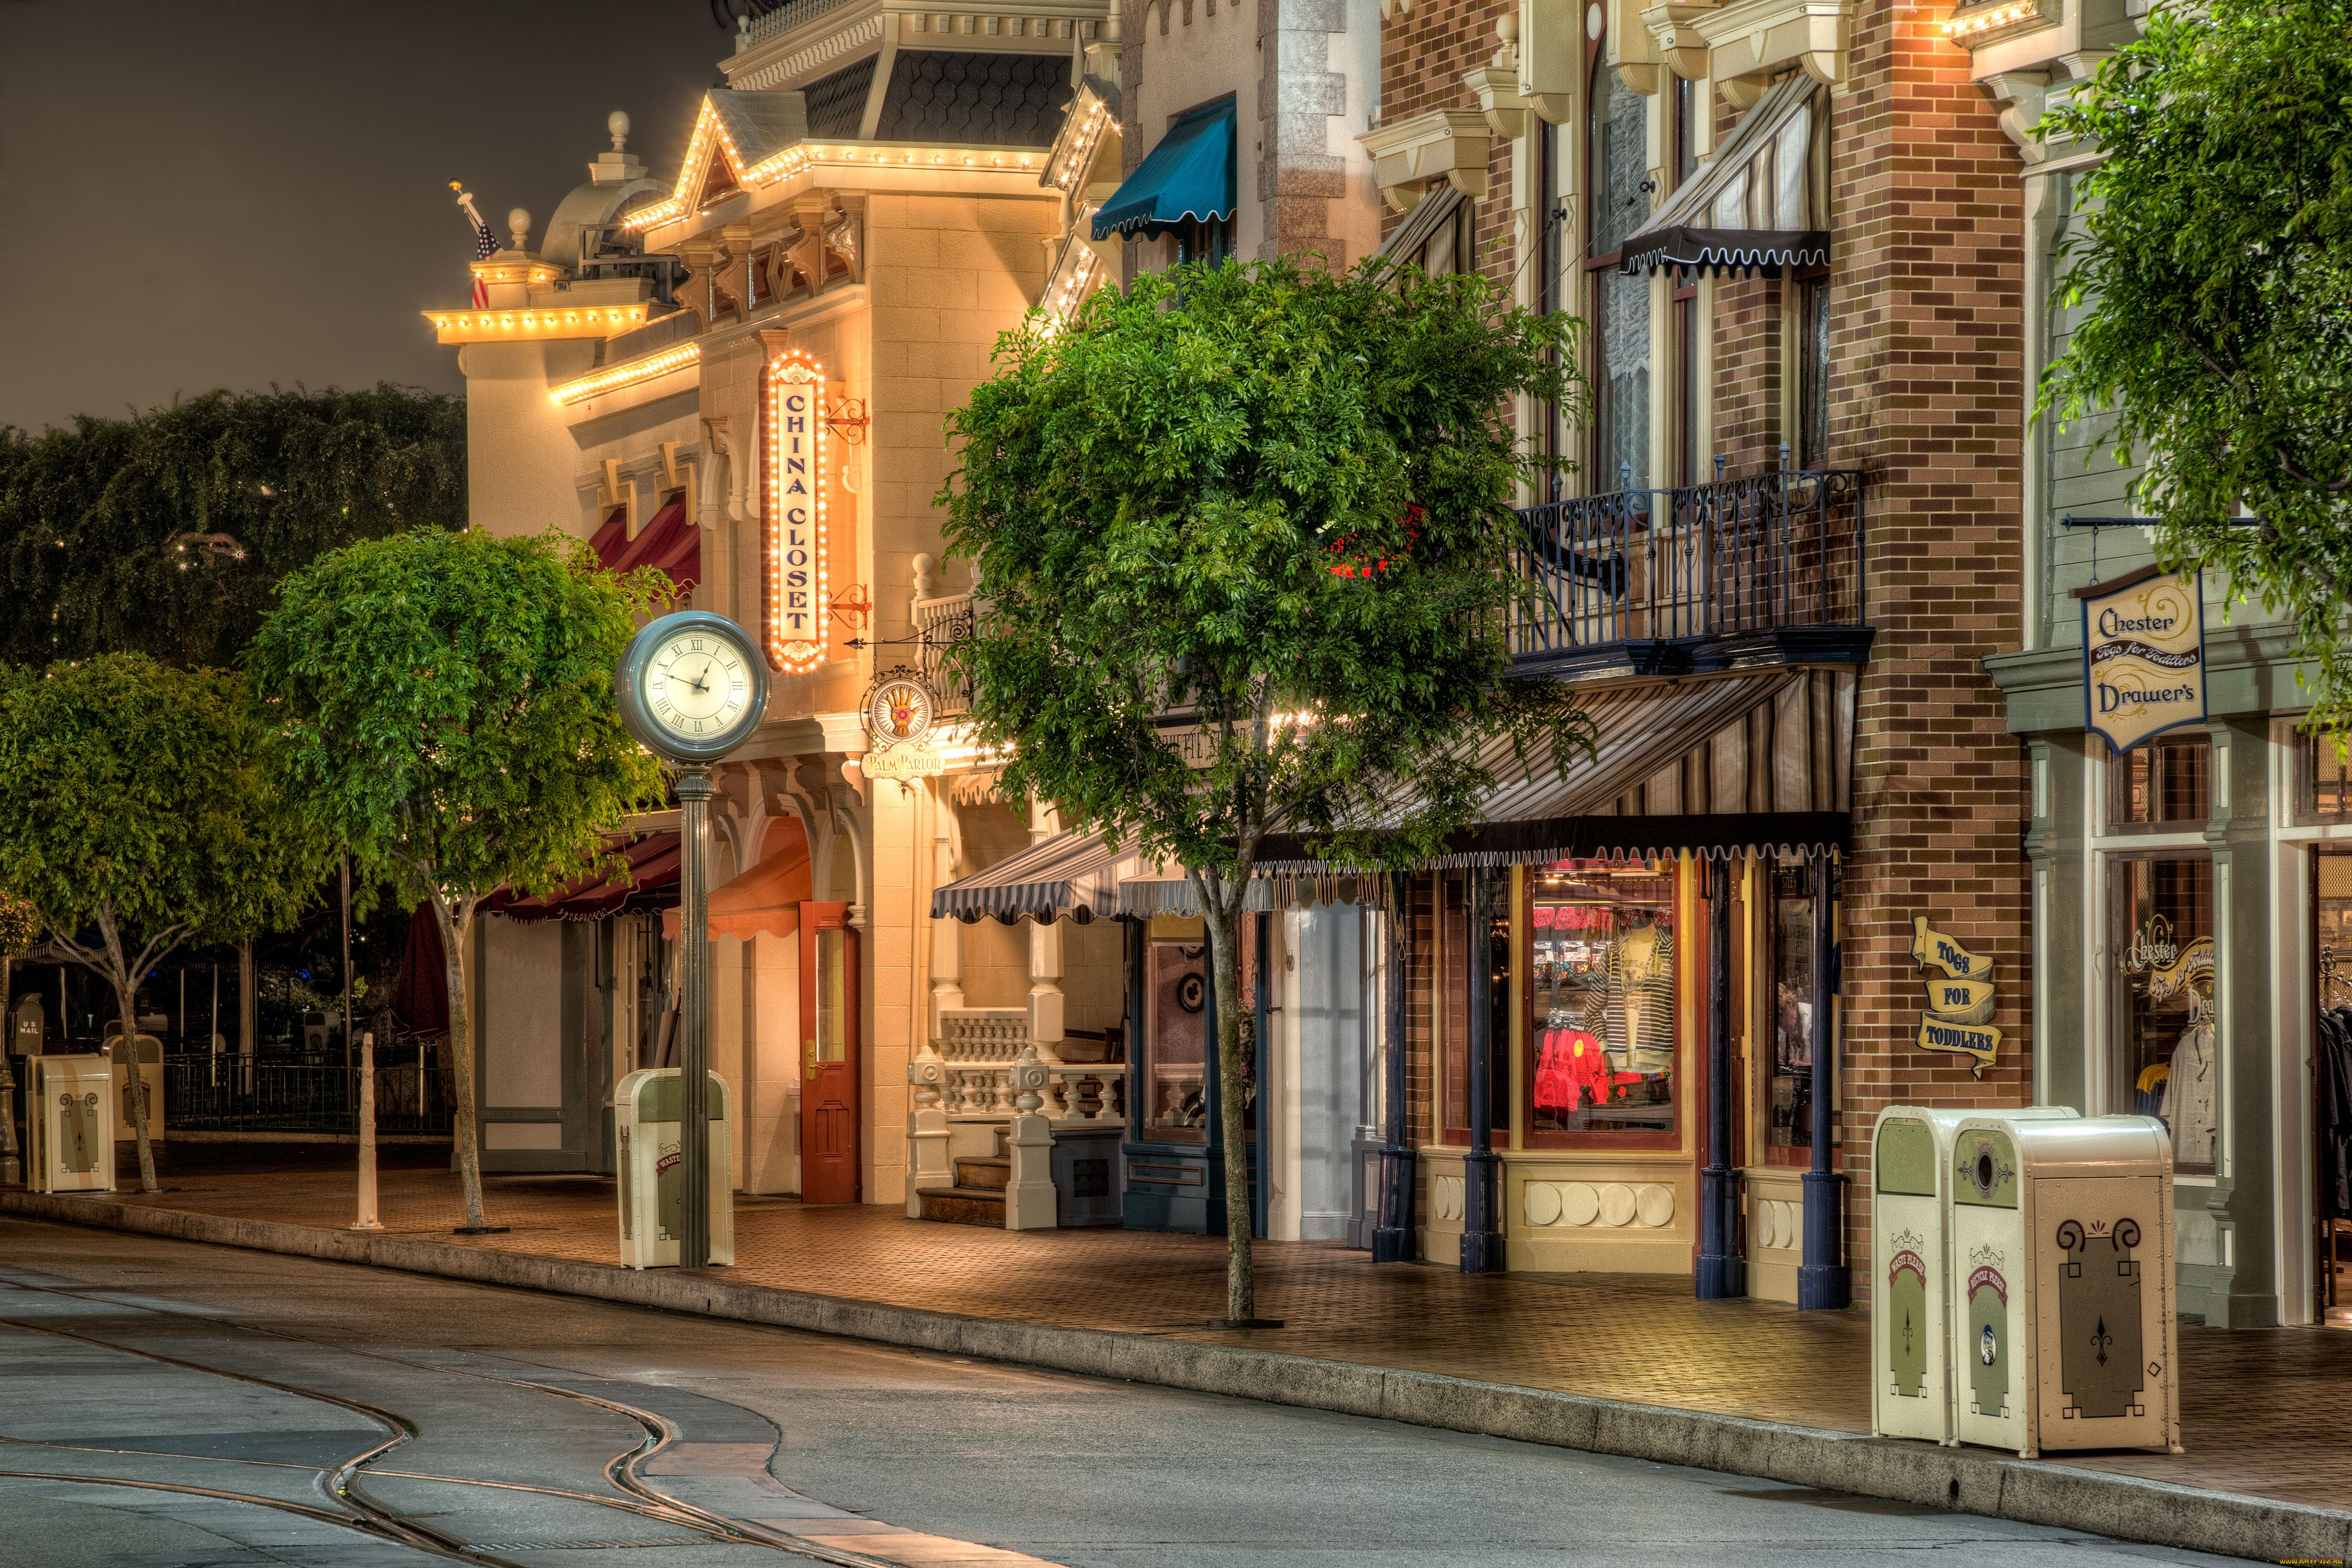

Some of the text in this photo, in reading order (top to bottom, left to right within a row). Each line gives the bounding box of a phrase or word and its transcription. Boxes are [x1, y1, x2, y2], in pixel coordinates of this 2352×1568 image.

[786, 395, 808, 629] CHINA CLOSET
[2099, 607, 2174, 638] Chester
[671, 644, 683, 657] XI
[691, 639, 703, 651] XII
[713, 645, 720, 655] I
[2096, 641, 2196, 667] Togs for Toddlers
[657, 661, 668, 670] X
[726, 660, 738, 670] II
[732, 681, 743, 690] III
[655, 697, 671, 715] VIII
[727, 701, 739, 712] IV
[2097, 682, 2195, 713] Drawer's
[671, 714, 685, 729] VII
[694, 721, 703, 732] VI
[715, 716, 724, 727] V
[866, 755, 941, 774] PALM PARLOR
[1936, 941, 1970, 974] TOGS
[2131, 928, 2178, 971] Chester
[1943, 987, 1971, 1006] FOR
[2151, 975, 2171, 1003] Togs
[1926, 1025, 1994, 1052] TODDLERS
[659, 1155, 680, 1168] WASTE
[1891, 1254, 1924, 1276] WASTE PLEASE
[1988, 1271, 2005, 1293] PLEASE
